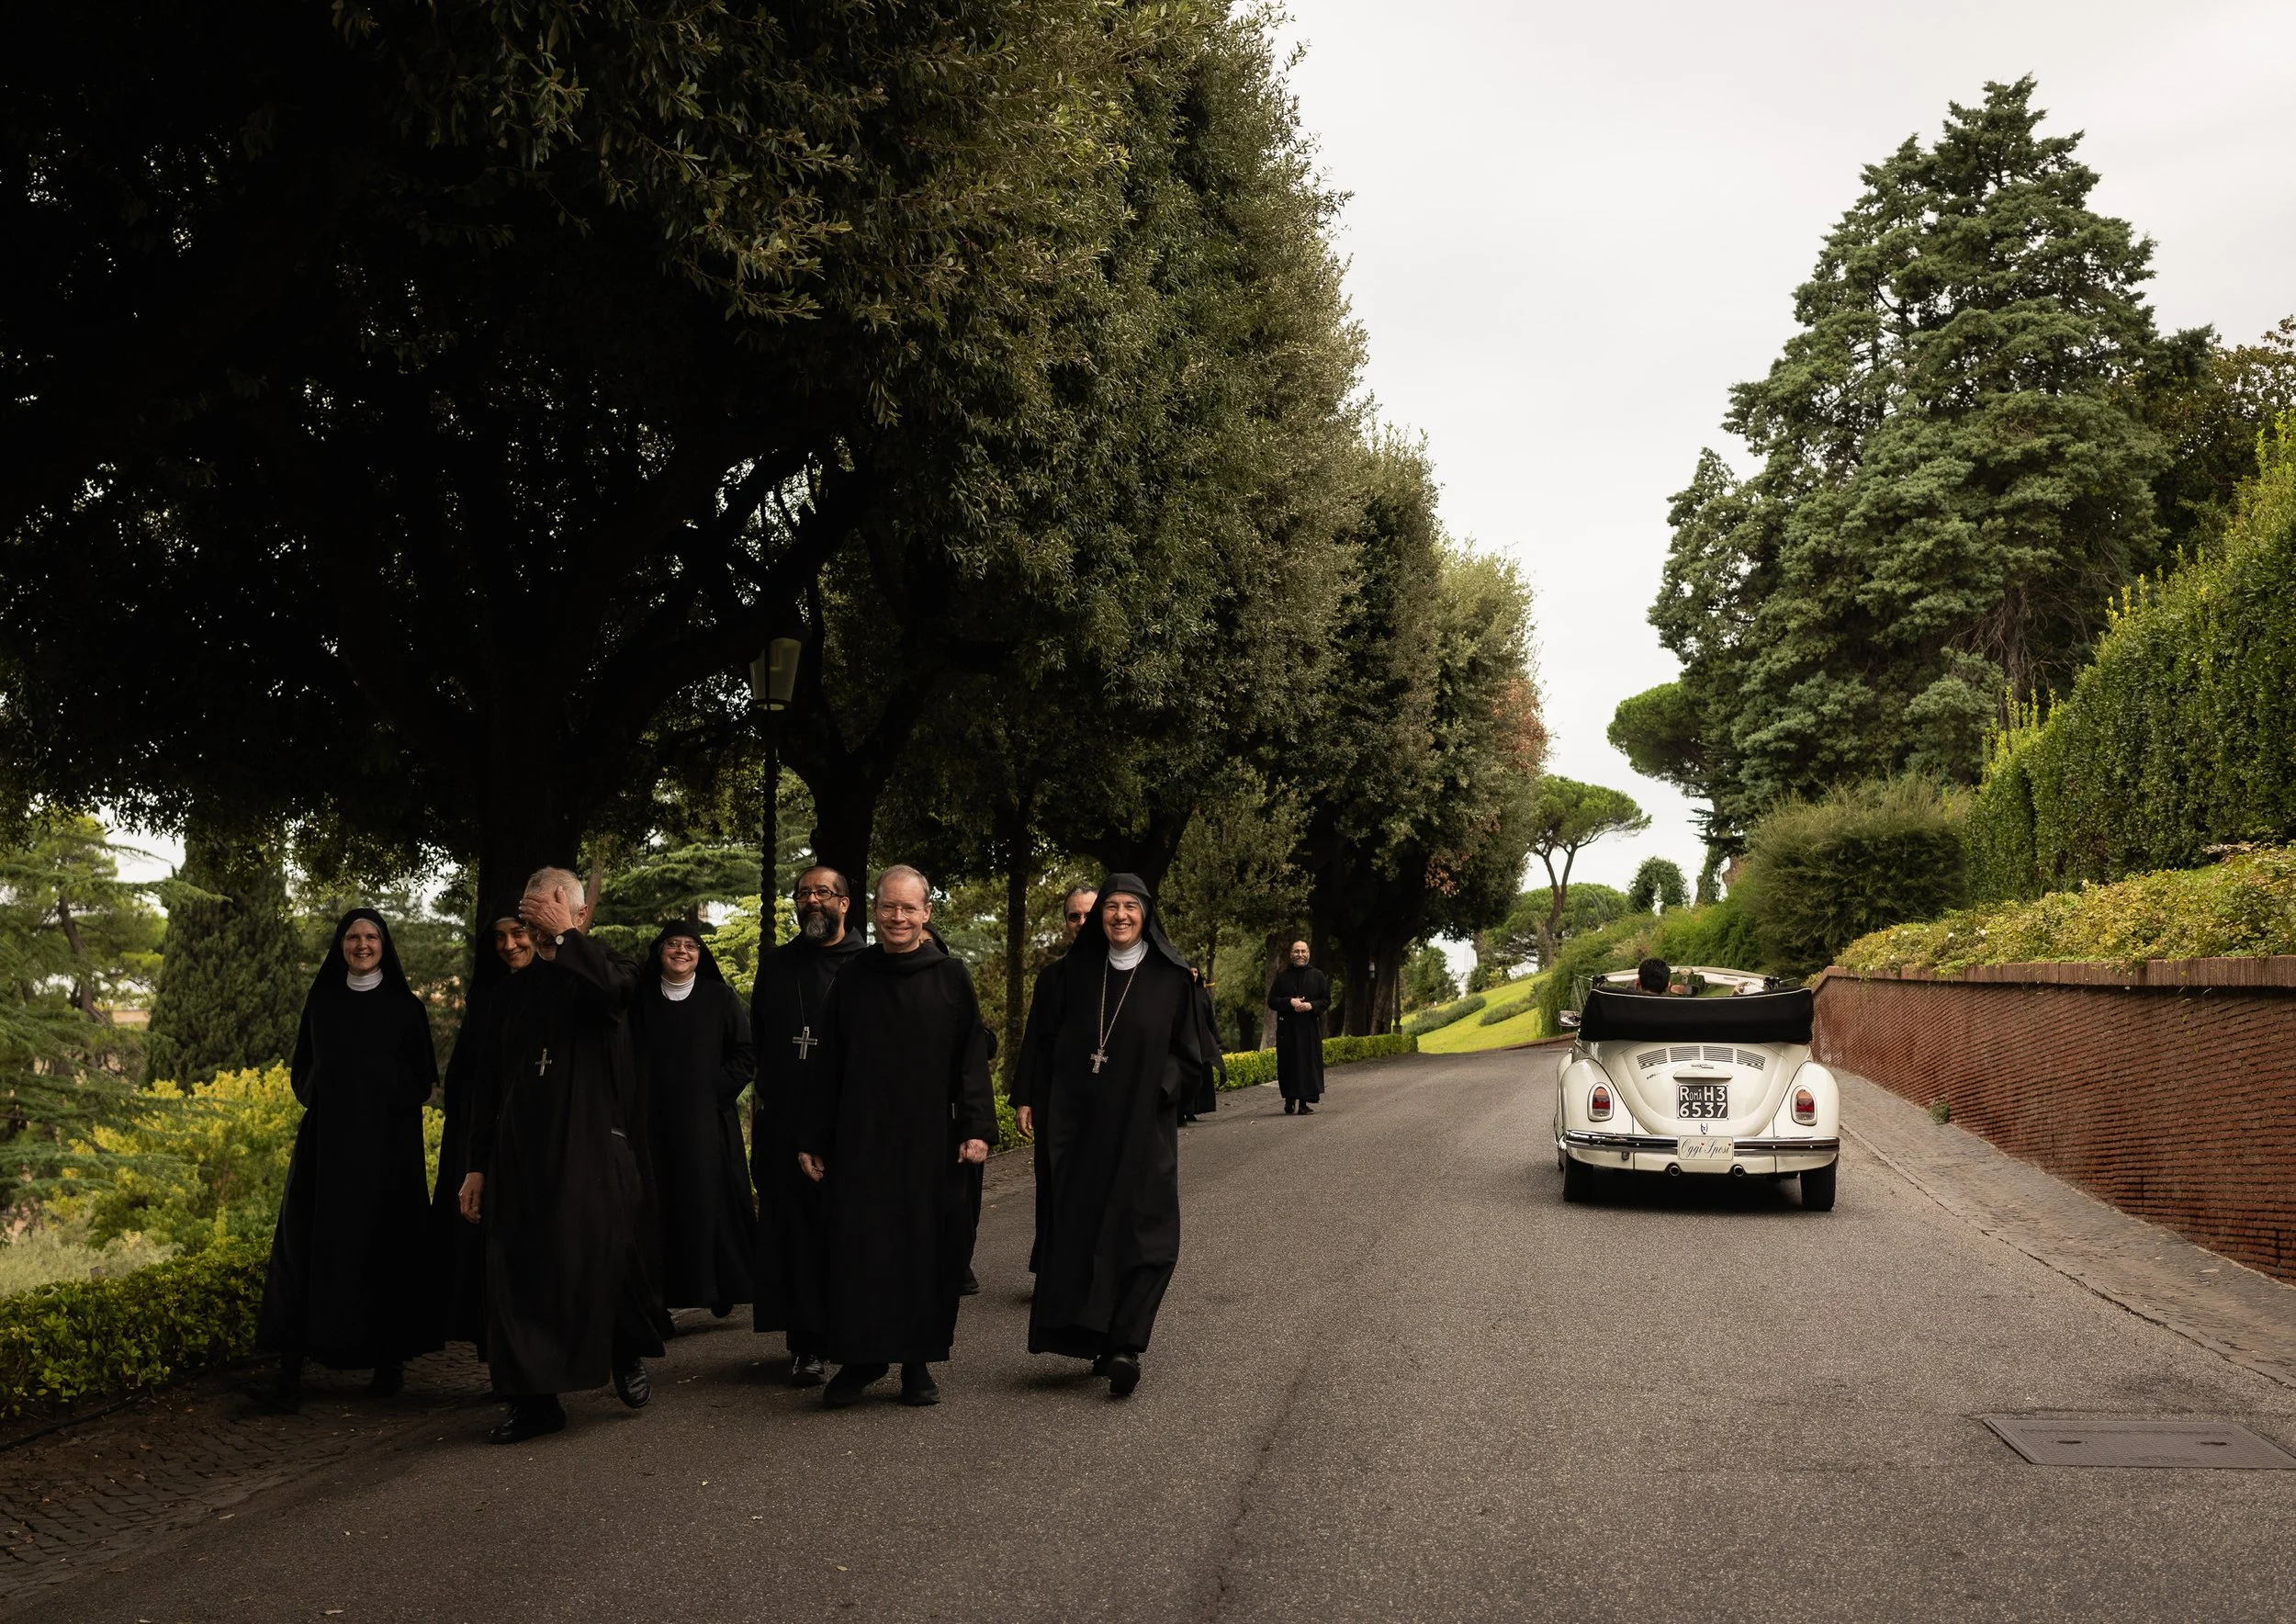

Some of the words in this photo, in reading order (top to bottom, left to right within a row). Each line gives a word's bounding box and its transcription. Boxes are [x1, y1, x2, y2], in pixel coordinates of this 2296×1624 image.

[1704, 1086, 1726, 1101] H3
[1680, 1102, 1727, 1118] 6537
[1681, 1138, 1704, 1158] Oggi
[1704, 1138, 1731, 1158] Sposi
